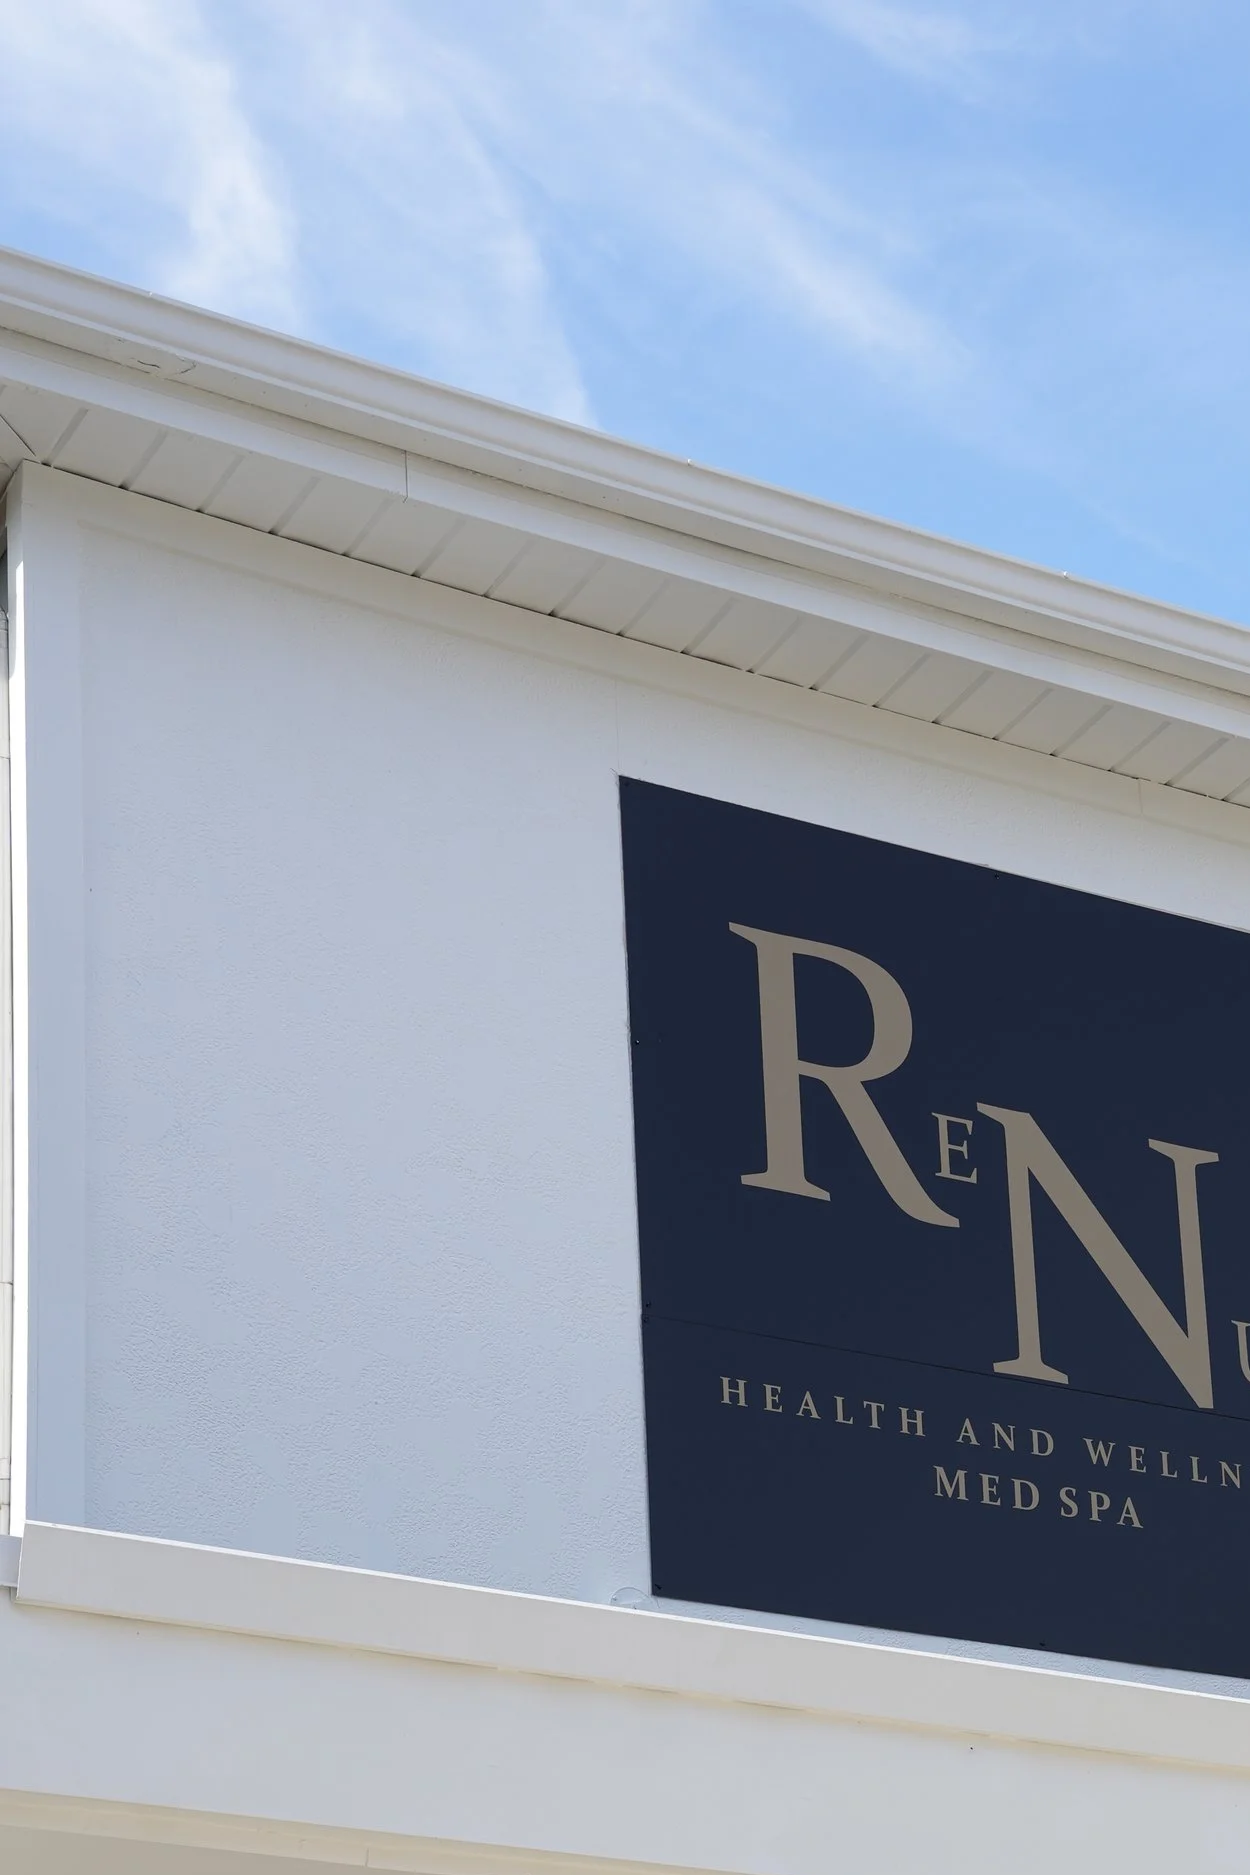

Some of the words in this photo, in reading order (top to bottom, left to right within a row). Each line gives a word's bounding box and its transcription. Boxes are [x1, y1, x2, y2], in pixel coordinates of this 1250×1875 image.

[720, 1375, 926, 1437] HEALTH
[956, 1417, 1055, 1458] AND
[933, 1465, 1041, 1513] MED
[1059, 1487, 1144, 1530] SPA
